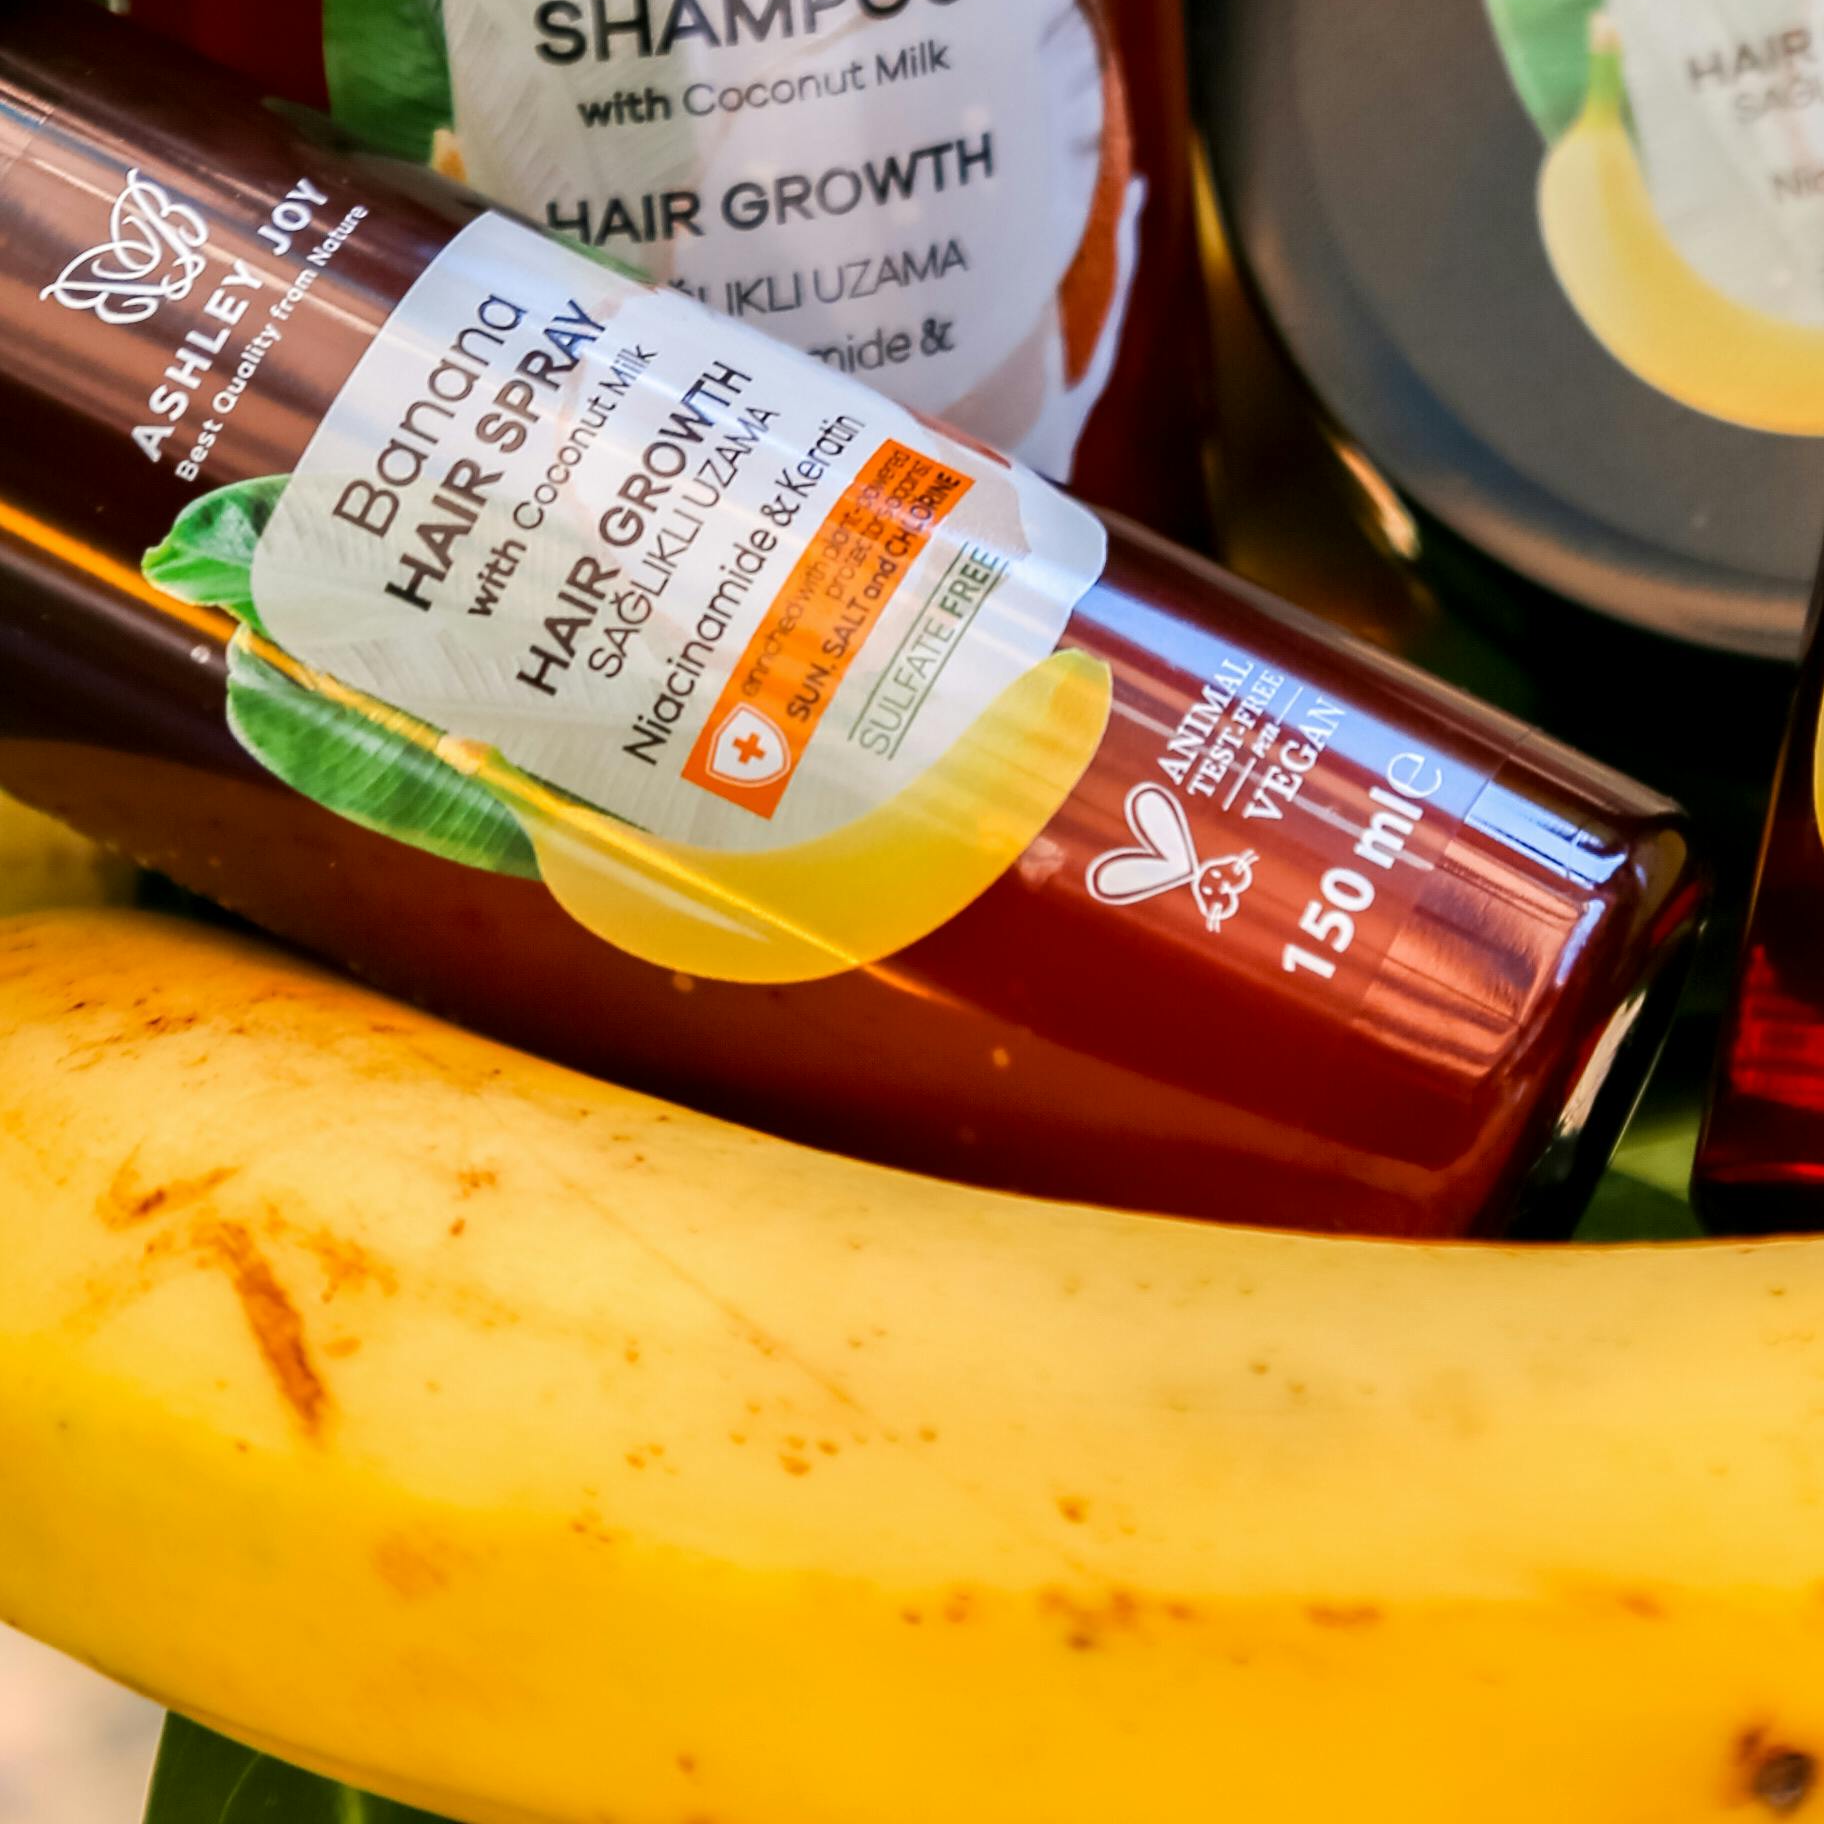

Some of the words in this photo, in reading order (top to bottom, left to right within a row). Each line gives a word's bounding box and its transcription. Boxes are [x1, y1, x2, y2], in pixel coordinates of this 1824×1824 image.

[578, 82, 672, 129] with
[684, 60, 866, 118] Coconut
[876, 40, 950, 88] Milk
[1687, 28, 1811, 90] HAIR
[547, 190, 705, 246] HAIR
[722, 133, 994, 230] GROWTH
[813, 239, 968, 303] UZAMA
[131, 259, 263, 462] ASHLEY
[258, 177, 328, 256] JOY
[175, 419, 224, 481] Best
[213, 324, 282, 414] Quality
[269, 269, 318, 320] from
[307, 205, 368, 265] Nature
[921, 318, 955, 356] &
[332, 292, 529, 537] Banana
[384, 460, 503, 612] HAIR
[476, 299, 608, 455] SPRAY
[467, 537, 517, 617] with
[513, 397, 617, 531] Coconut
[611, 345, 656, 398] Milk
[774, 414, 865, 498] Keratin
[517, 557, 619, 695] HAIR
[599, 361, 753, 549] GROWTH
[588, 514, 699, 678] SAĞLIKLI
[696, 406, 780, 515] UZAMA
[760, 494, 800, 527] &
[822, 597, 869, 659] SALT
[862, 556, 897, 600] and
[884, 471, 960, 559] CHLORINE
[623, 527, 777, 765] Niacinamide
[859, 618, 955, 754] SULFATE
[940, 547, 998, 619] FREE
[1157, 657, 1254, 785] ANIMAL
[1187, 669, 1285, 797] TEST-FREE
[1243, 695, 1347, 820] VEGAN
[1282, 867, 1375, 979] 150
[1354, 785, 1424, 869] ml
